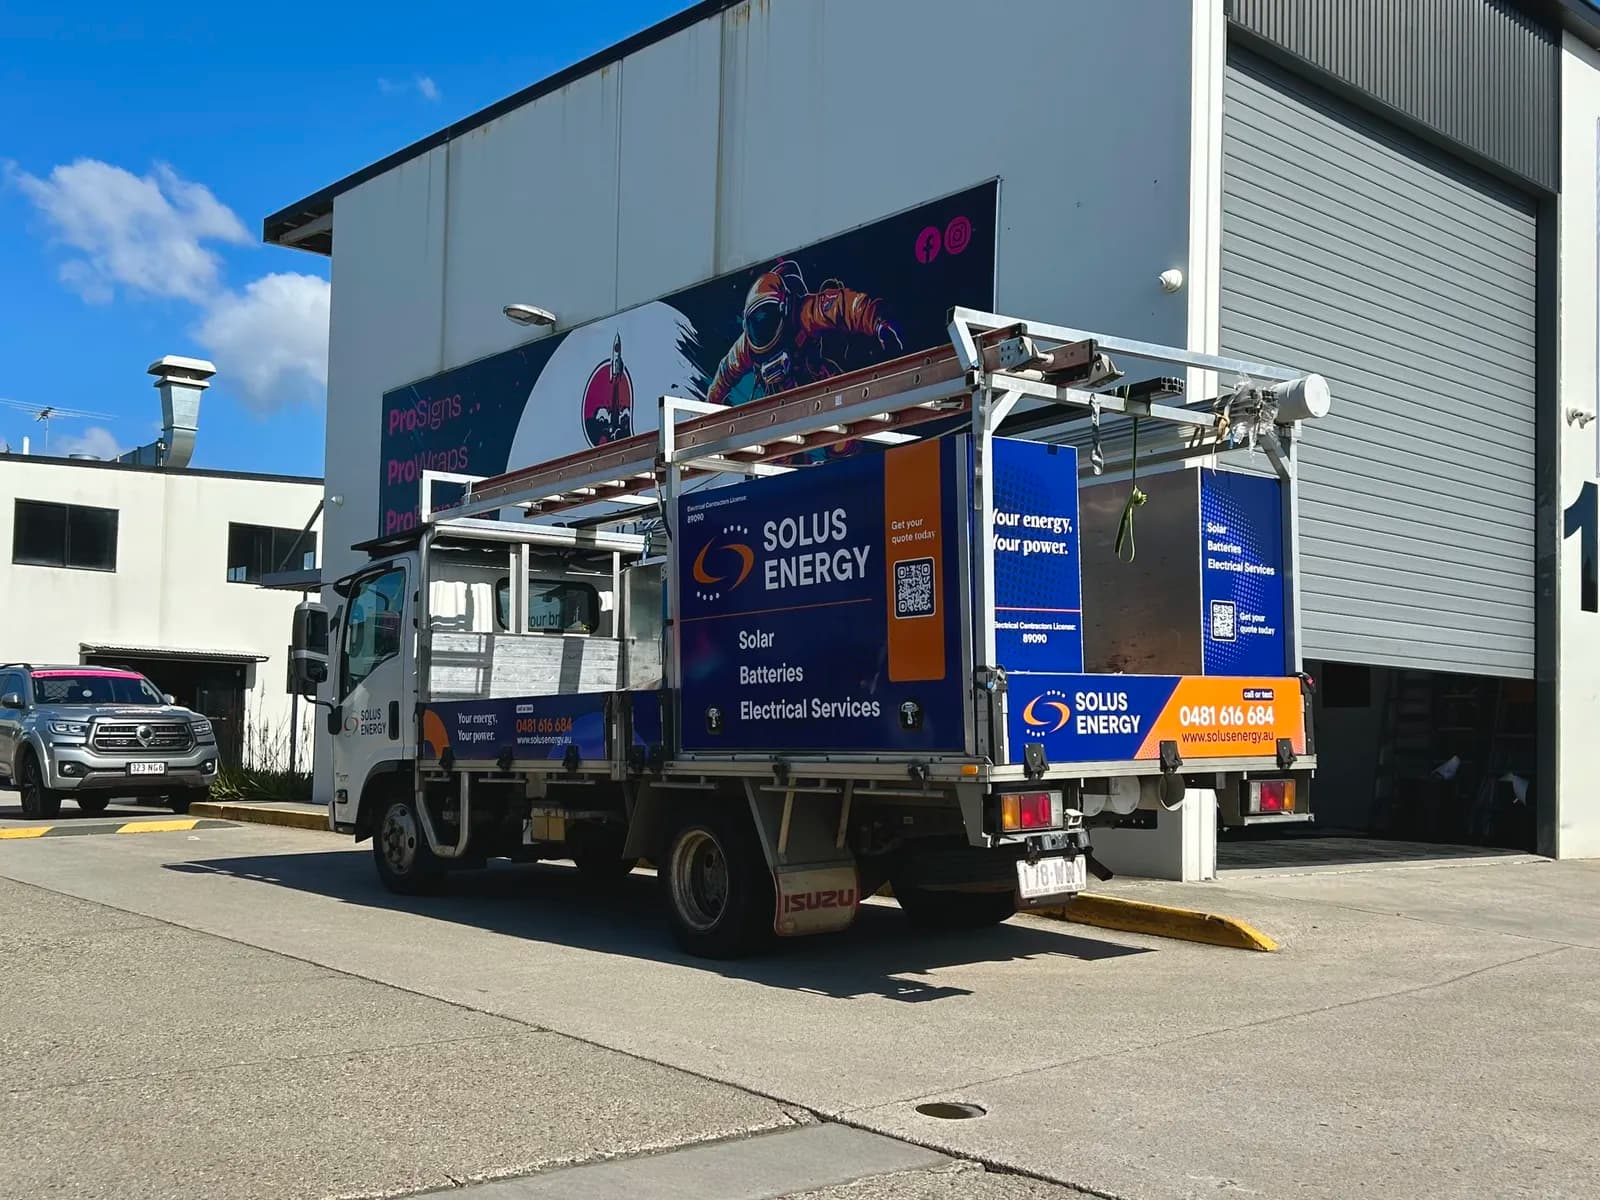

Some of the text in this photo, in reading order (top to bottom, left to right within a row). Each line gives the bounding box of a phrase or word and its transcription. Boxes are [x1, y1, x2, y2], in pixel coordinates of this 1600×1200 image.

[388, 394, 462, 436] ProSigns
[763, 508, 848, 552] SOLUS
[891, 518, 923, 530] Get your
[1023, 514, 1073, 534] energy,
[1207, 522, 1228, 535] Solar
[891, 530, 936, 544] quote today
[1023, 538, 1069, 556] power.
[1207, 540, 1242, 554] Batteries
[1564, 481, 1598, 613] 1
[764, 545, 871, 590] ENERGY
[1208, 558, 1276, 576] Electrical Services
[1239, 612, 1252, 622] Get
[739, 630, 775, 649] Solar
[1022, 633, 1048, 644] 89090
[740, 663, 804, 684] Batteries
[740, 697, 881, 720] Electrical Services
[1075, 692, 1129, 712] SOLUS
[360, 708, 382, 721] SOLUS
[457, 713, 472, 724] Your
[1179, 705, 1275, 727] 0481 616 684
[360, 722, 387, 736] ENERGY
[516, 716, 573, 733] 0481 616 684
[1076, 714, 1141, 735] ENERGY
[457, 730, 496, 743] Your power.
[516, 735, 572, 746] www.solusenergy.au
[1181, 729, 1275, 744] www.solusenergy.au
[784, 888, 855, 914] ISUZU
